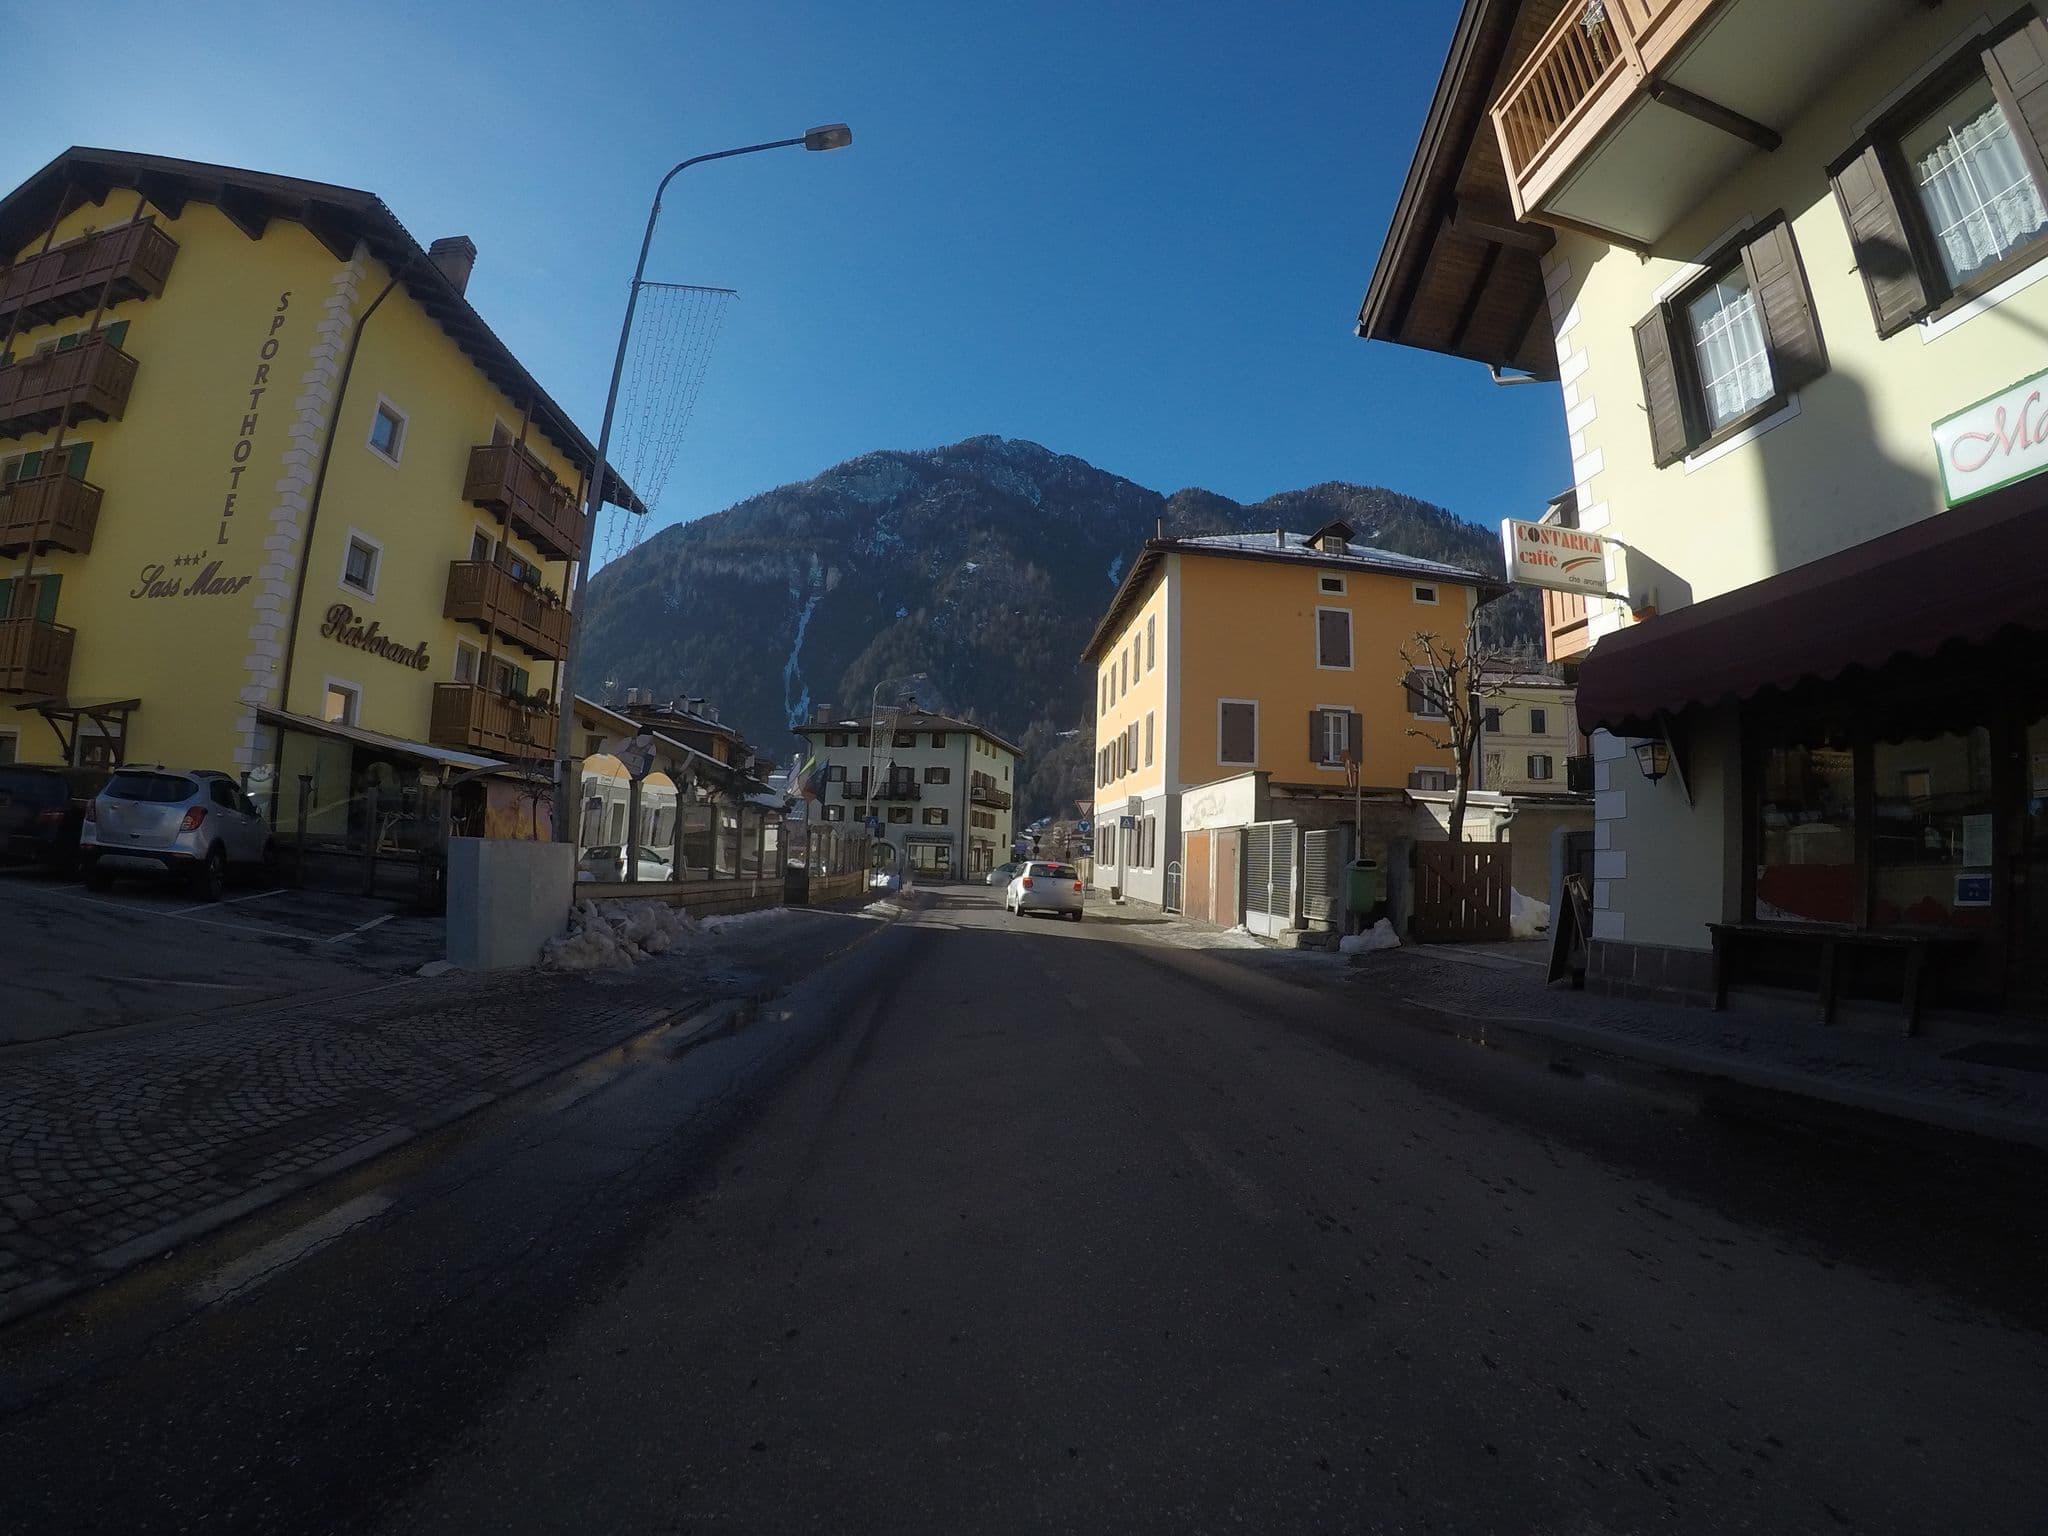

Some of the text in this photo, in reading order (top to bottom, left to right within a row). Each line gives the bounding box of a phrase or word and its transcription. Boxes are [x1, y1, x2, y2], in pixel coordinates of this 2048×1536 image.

[217, 291, 292, 545] SPORTHOTEL
[1516, 525, 1602, 554] COSTARICA
[1519, 549, 1558, 567] caffè
[129, 560, 253, 599] Sass Maor
[321, 603, 430, 671] Ristorante
